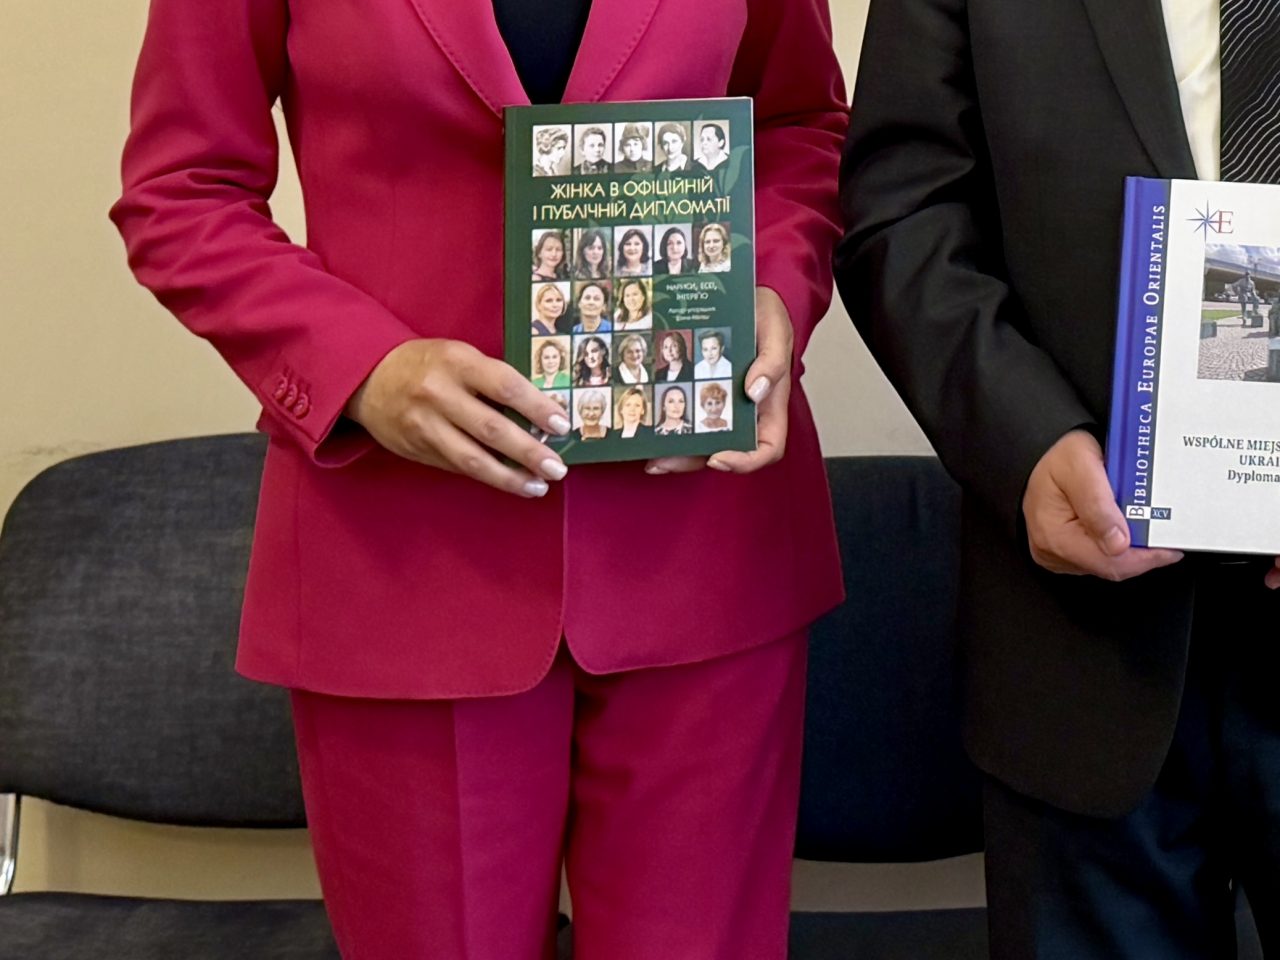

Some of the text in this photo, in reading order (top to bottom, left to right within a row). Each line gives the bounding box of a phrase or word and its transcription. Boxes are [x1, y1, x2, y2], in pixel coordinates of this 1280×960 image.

[550, 175, 713, 199] ЖІНКА В ОФІЦІЙНІЙ
[532, 195, 731, 221] І ПУБЛІЧНІЙ ДИПЛОМАТІЇ
[1128, 204, 1165, 518] BIBLIOTHECA EUROPAE ORIENTALIS
[1182, 434, 1244, 450] WSPÓLNE
